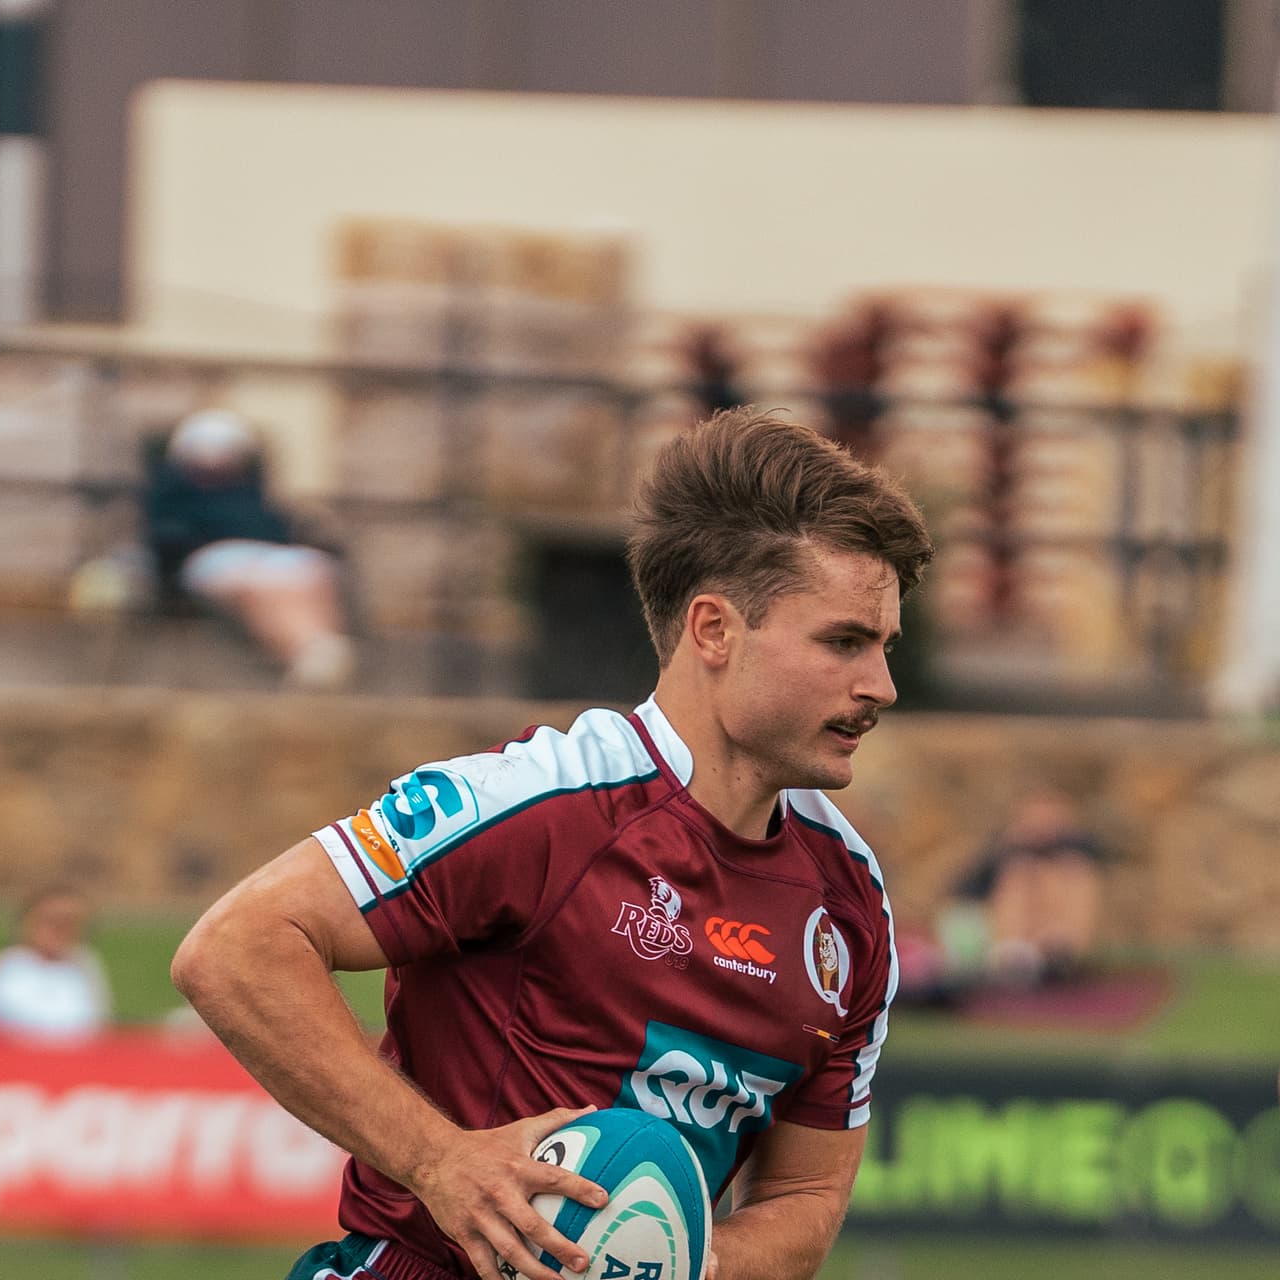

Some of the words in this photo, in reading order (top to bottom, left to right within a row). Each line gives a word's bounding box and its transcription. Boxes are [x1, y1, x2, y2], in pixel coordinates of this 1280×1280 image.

[611, 902, 693, 961] REDS
[713, 954, 777, 984] canterbury
[630, 1050, 786, 1133] QUT
